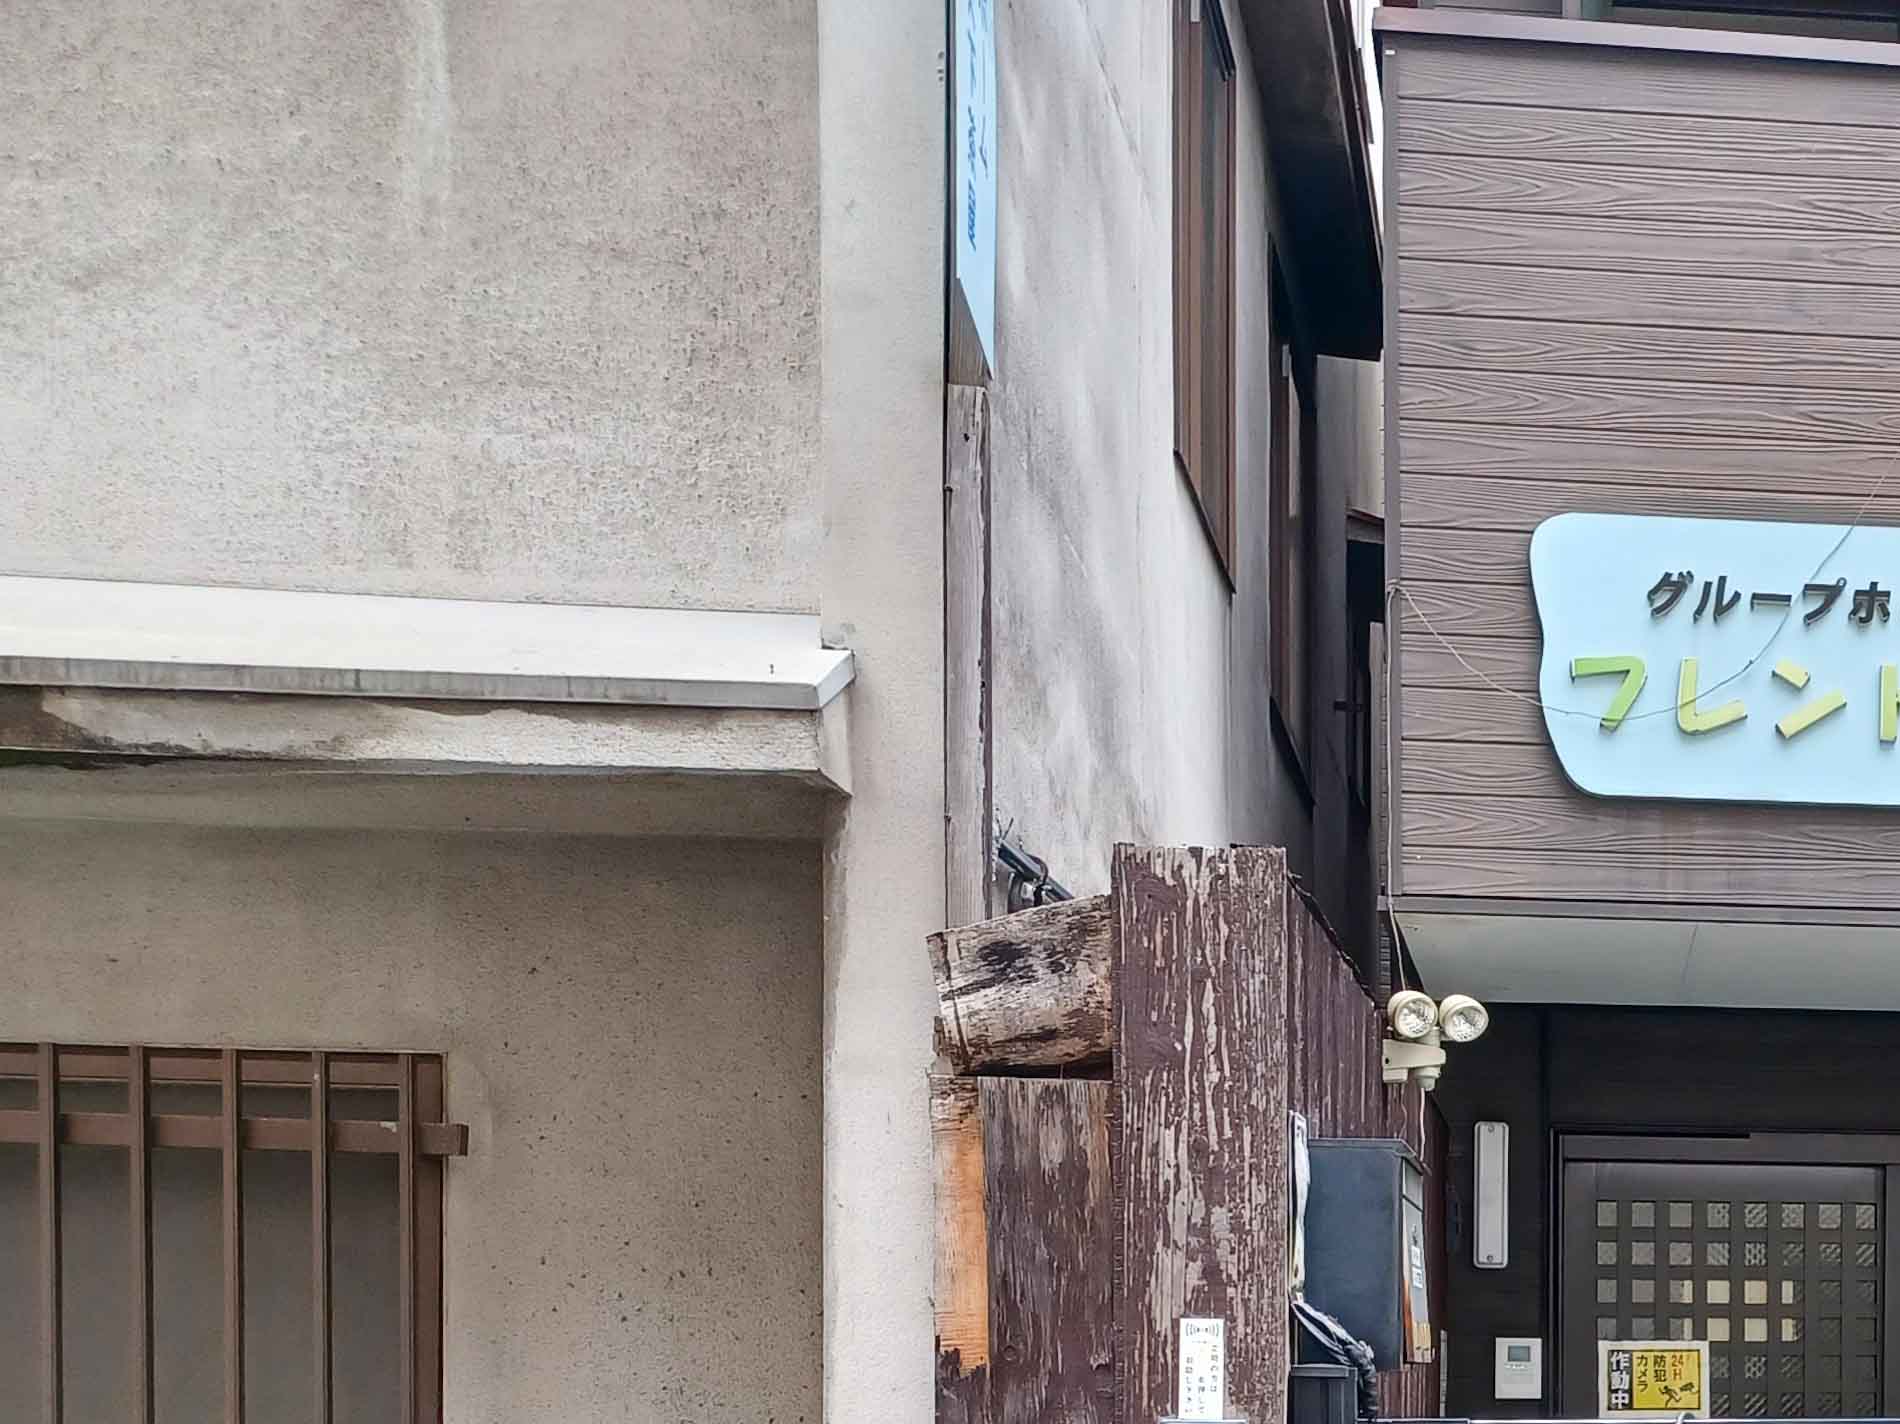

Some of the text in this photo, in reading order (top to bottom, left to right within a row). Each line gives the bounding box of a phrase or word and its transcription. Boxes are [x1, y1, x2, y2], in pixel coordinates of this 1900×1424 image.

[1609, 1351, 1631, 1410] 作動中
[1637, 1354, 1649, 1393] カメラ
[1653, 1354, 1667, 1382] 防犯
